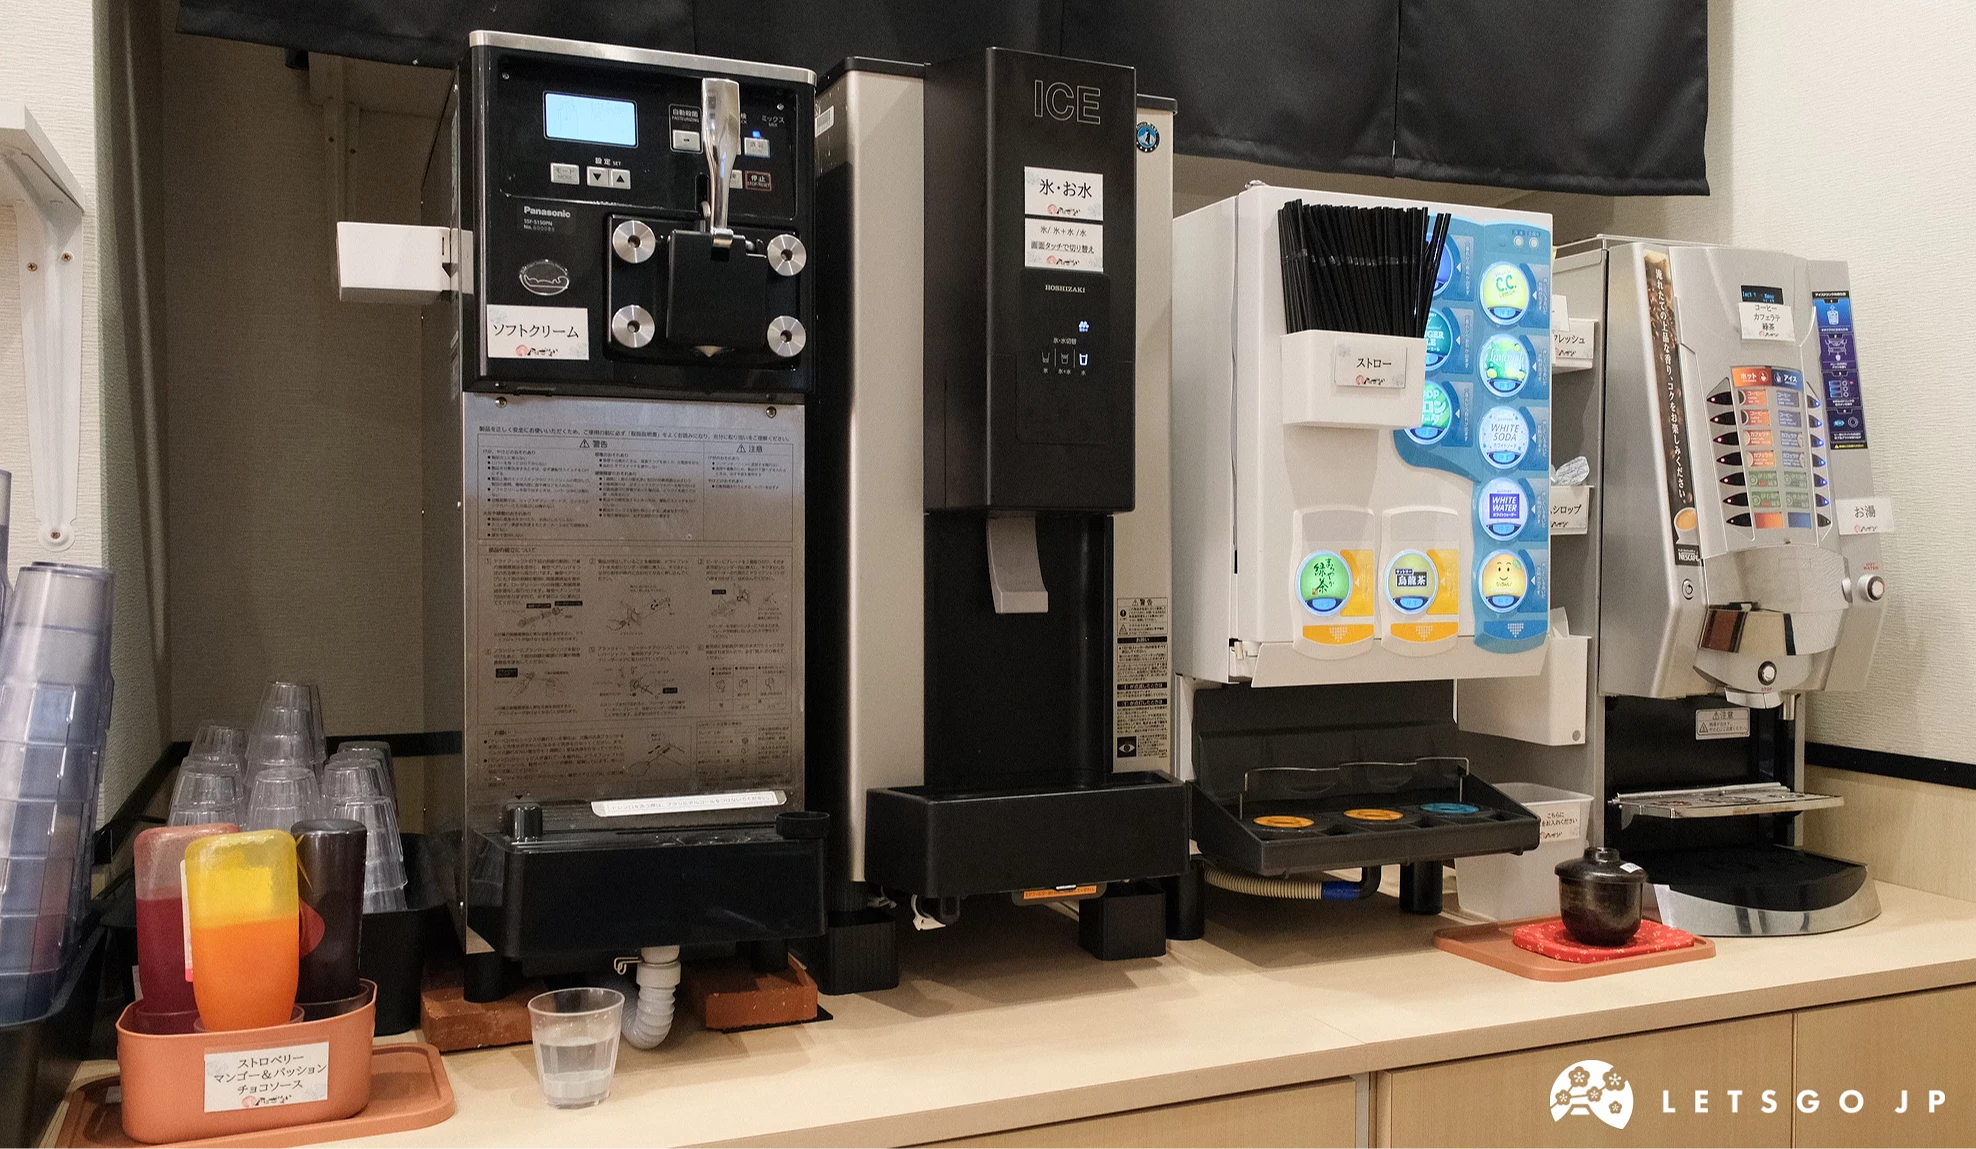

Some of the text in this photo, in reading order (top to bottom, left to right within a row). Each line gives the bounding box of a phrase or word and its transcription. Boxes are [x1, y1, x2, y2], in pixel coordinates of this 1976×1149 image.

[1034, 80, 1101, 125] ICE
[761, 114, 785, 123] ミックス
[750, 174, 766, 182] 停止
[1039, 178, 1093, 199] 氷・お水
[523, 205, 571, 219] Panasonic
[1030, 241, 1095, 255] 画面タッチで切り替え
[1496, 274, 1517, 292] C.C.
[1045, 284, 1086, 293] HOSHIZAKI
[1754, 304, 1778, 312] コーヒー
[1753, 313, 1781, 322] カフェラテ
[493, 323, 580, 339] ソフトクリーム
[1762, 323, 1775, 331] 緑茶
[1356, 357, 1392, 369] ストロー
[1740, 372, 1757, 380] ホット
[1783, 374, 1798, 383] アイス
[1491, 423, 1520, 433] WHITE
[1493, 432, 1518, 442] SODA
[592, 439, 608, 449] 警告
[748, 444, 764, 453] 注意
[1492, 496, 1518, 504] WHITE
[1492, 503, 1518, 512] WATER
[1550, 503, 1582, 515] シロップ
[1854, 505, 1876, 518] お湯
[1313, 562, 1329, 594] 緑茶
[1397, 574, 1426, 587] 烏龍茶
[237, 1053, 304, 1070] ストロベリー
[236, 1079, 303, 1095] チョコソース
